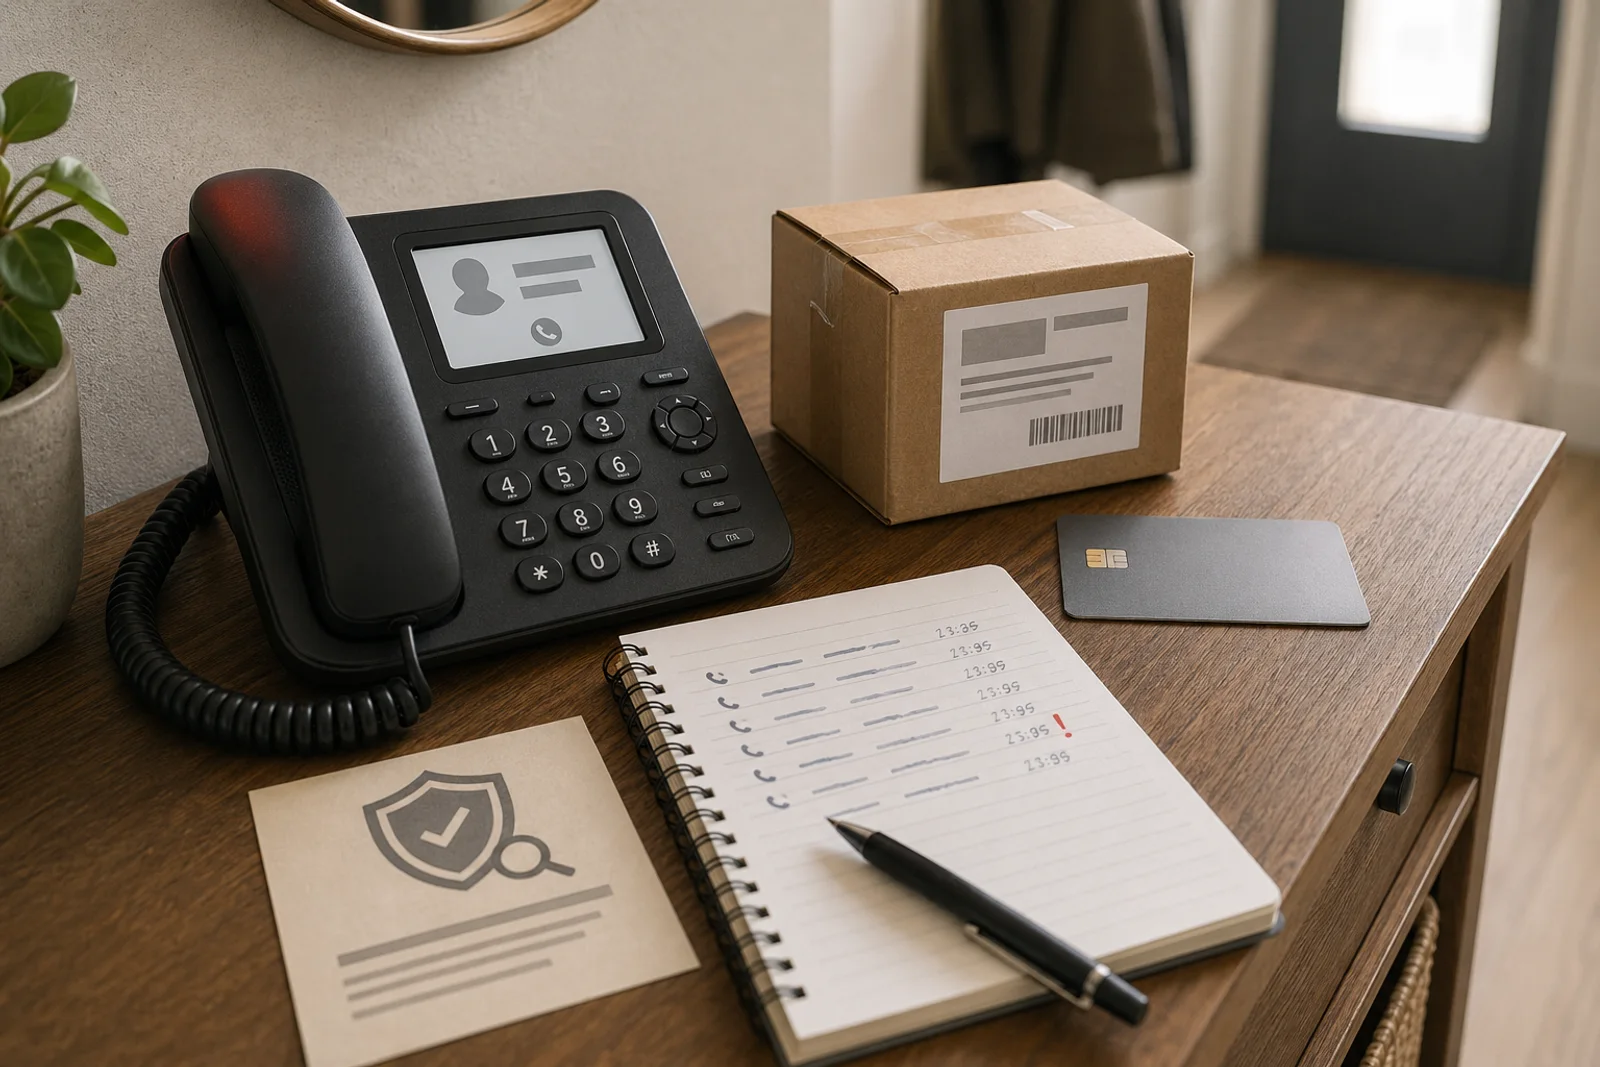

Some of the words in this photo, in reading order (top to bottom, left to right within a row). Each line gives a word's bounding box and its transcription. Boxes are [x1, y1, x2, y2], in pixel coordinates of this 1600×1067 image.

[485, 434, 498, 452] 1
[541, 425, 557, 442] 2
[595, 415, 610, 433] 3
[501, 476, 515, 494] 4
[556, 466, 571, 484] 5
[612, 455, 626, 473] 6
[515, 519, 528, 538] 7
[573, 508, 588, 526] 8
[628, 497, 642, 515] 9
[590, 551, 605, 570] 0
[645, 539, 660, 558] #
[1052, 713, 1073, 739] !
